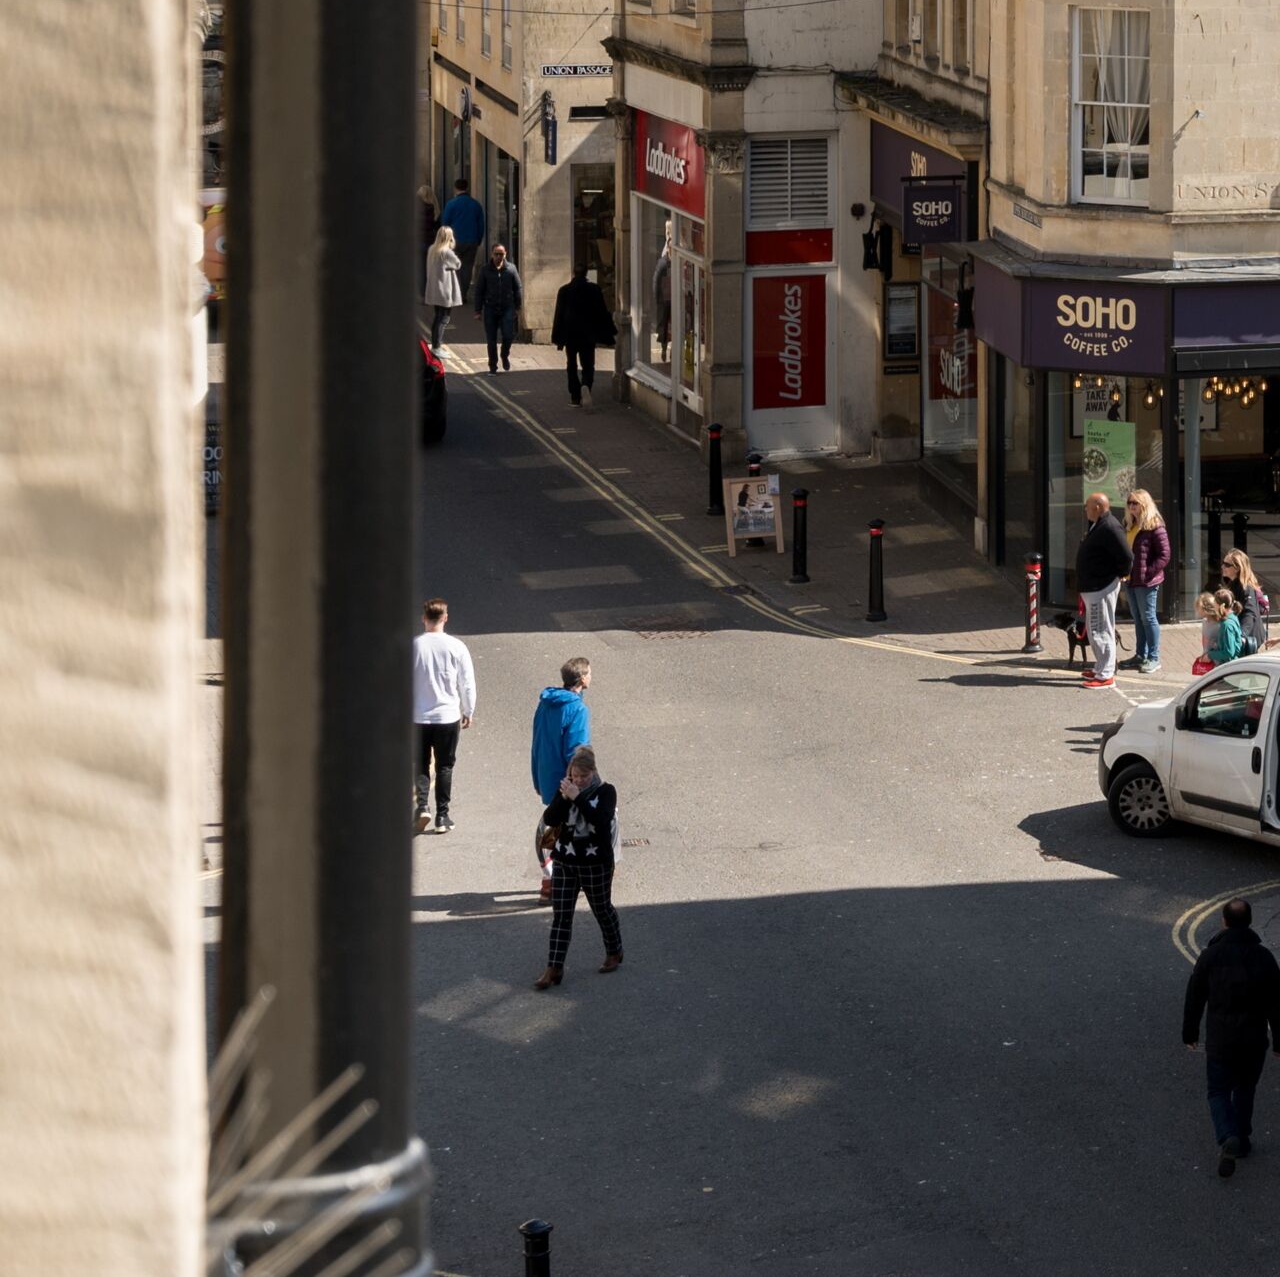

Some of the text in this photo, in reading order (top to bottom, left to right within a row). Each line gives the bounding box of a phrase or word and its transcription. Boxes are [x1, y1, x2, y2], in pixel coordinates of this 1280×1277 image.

[544, 67, 612, 75] UNION PASSAGE
[646, 138, 686, 185] Ladbrokes
[1177, 185, 1246, 200] UNION
[912, 201, 952, 216] SOHO
[915, 217, 938, 227] COFFEE
[1056, 294, 1136, 331] SOHO
[779, 283, 801, 400] Ladbrokes
[1063, 333, 1108, 356] COFFEE
[940, 348, 961, 396] SOHO
[1086, 390, 1106, 400] TAKE
[1085, 402, 1108, 412] AWAY
